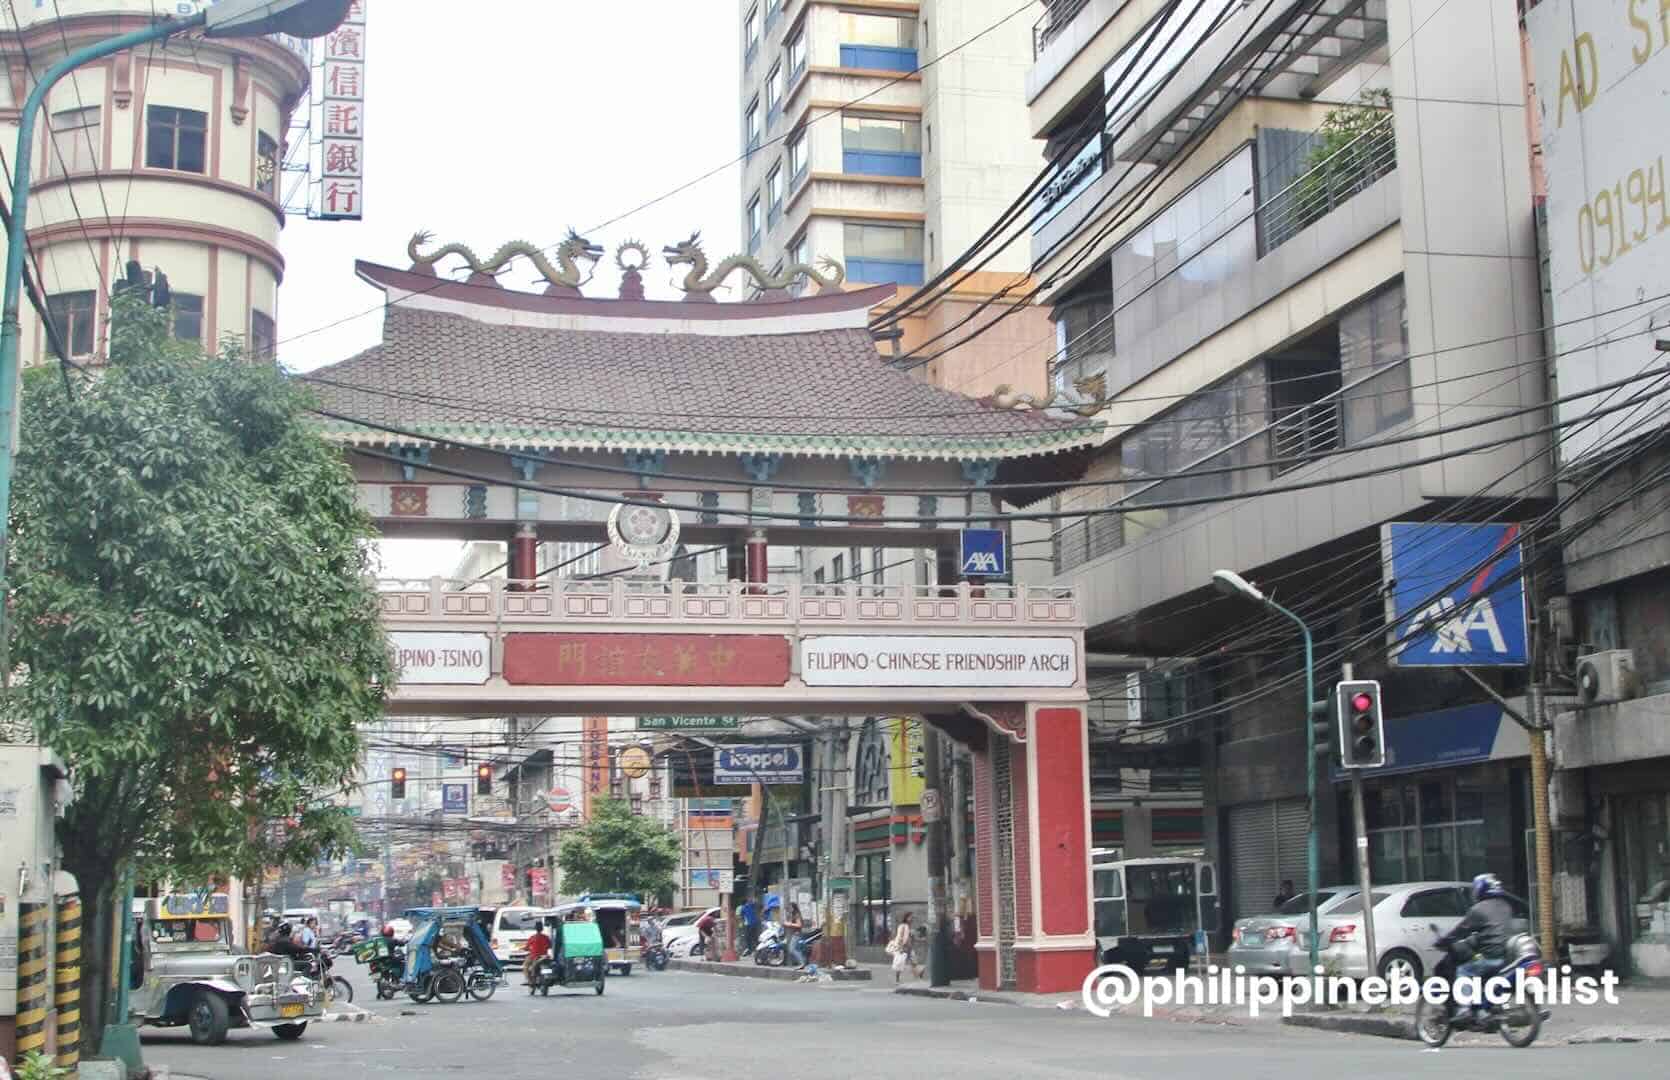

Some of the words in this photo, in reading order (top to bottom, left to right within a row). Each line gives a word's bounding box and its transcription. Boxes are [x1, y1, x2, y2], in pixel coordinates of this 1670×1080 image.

[1558, 31, 1598, 128] AD
[1578, 155, 1670, 273] 09194
[963, 552, 999, 571] AXA
[392, 649, 482, 668] LIPINO-TSINO
[946, 652, 1026, 672] FRIENDSHIP
[1029, 653, 1070, 672] ARCH
[643, 716, 666, 726] San
[672, 715, 716, 726] Vicente
[721, 716, 734, 726] St
